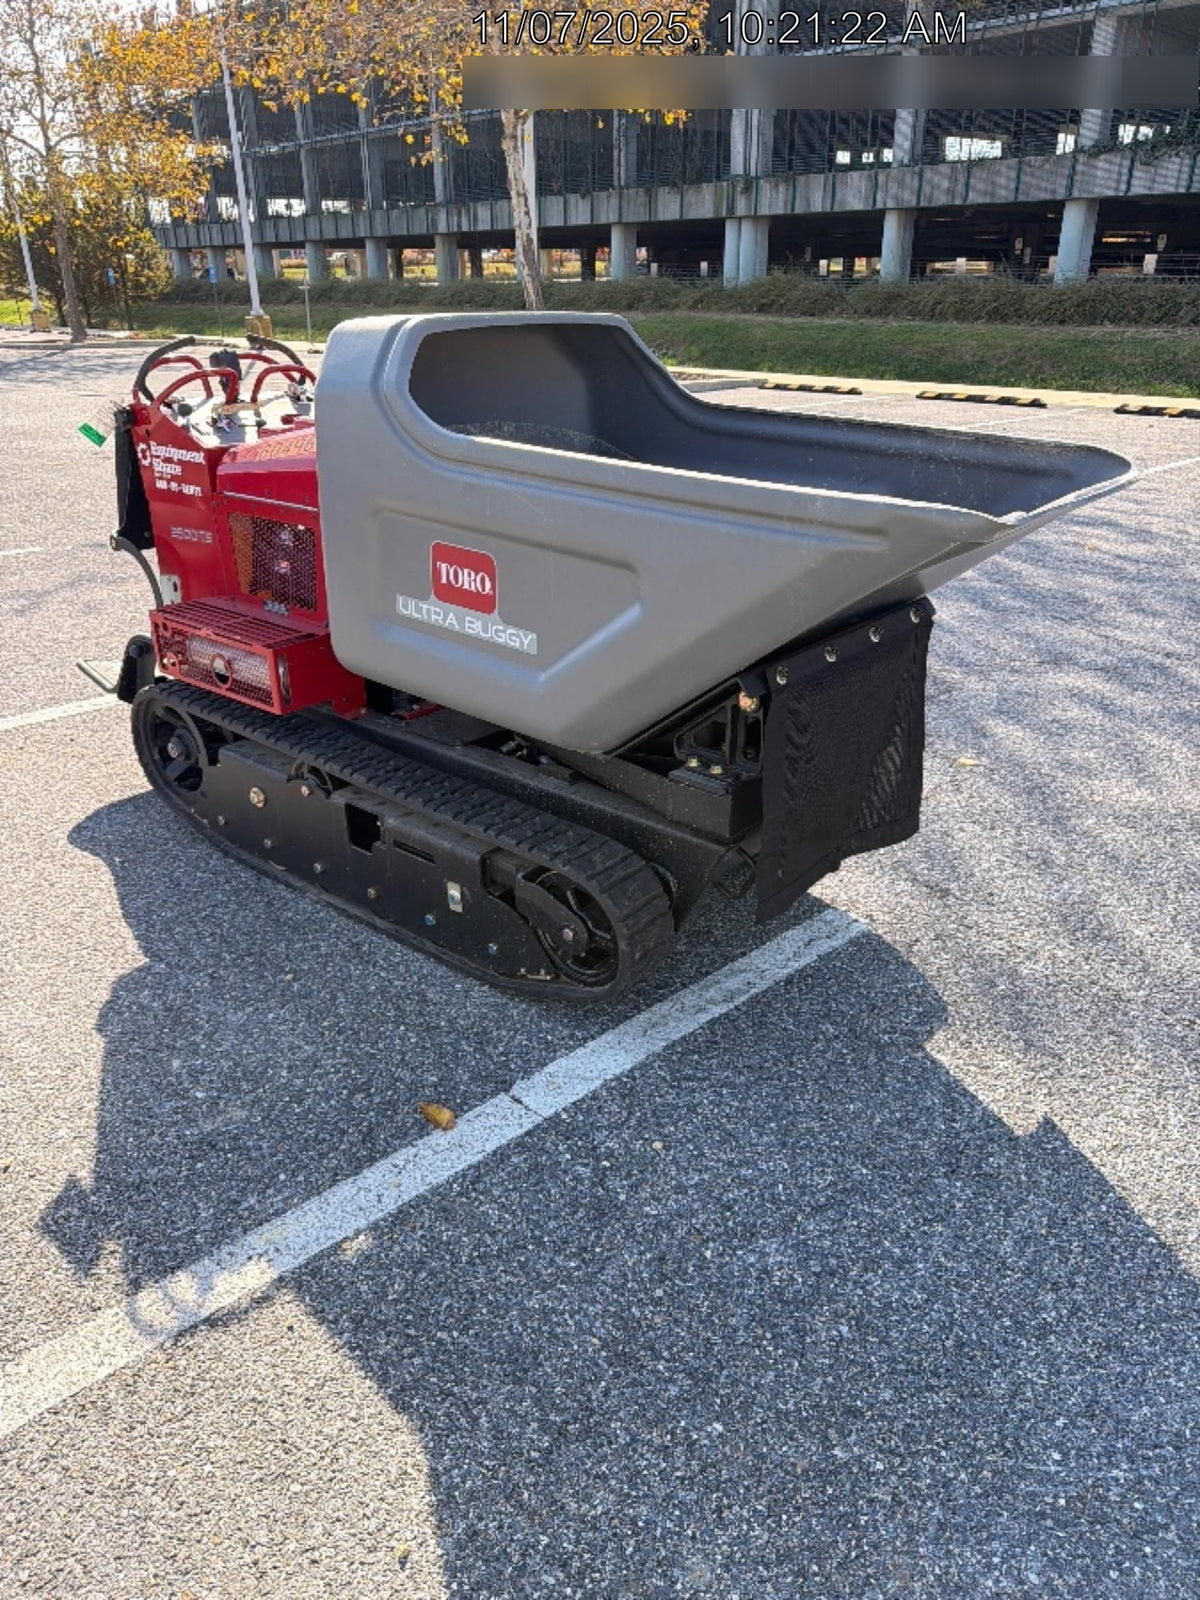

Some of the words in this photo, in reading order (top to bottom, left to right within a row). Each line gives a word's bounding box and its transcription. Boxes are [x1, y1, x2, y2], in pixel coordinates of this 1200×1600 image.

[149, 440, 206, 464] Equipment
[153, 457, 182, 475] Share
[436, 561, 493, 595] TORO
[399, 597, 460, 631] ULTRA
[465, 616, 535, 650] BUGGY
